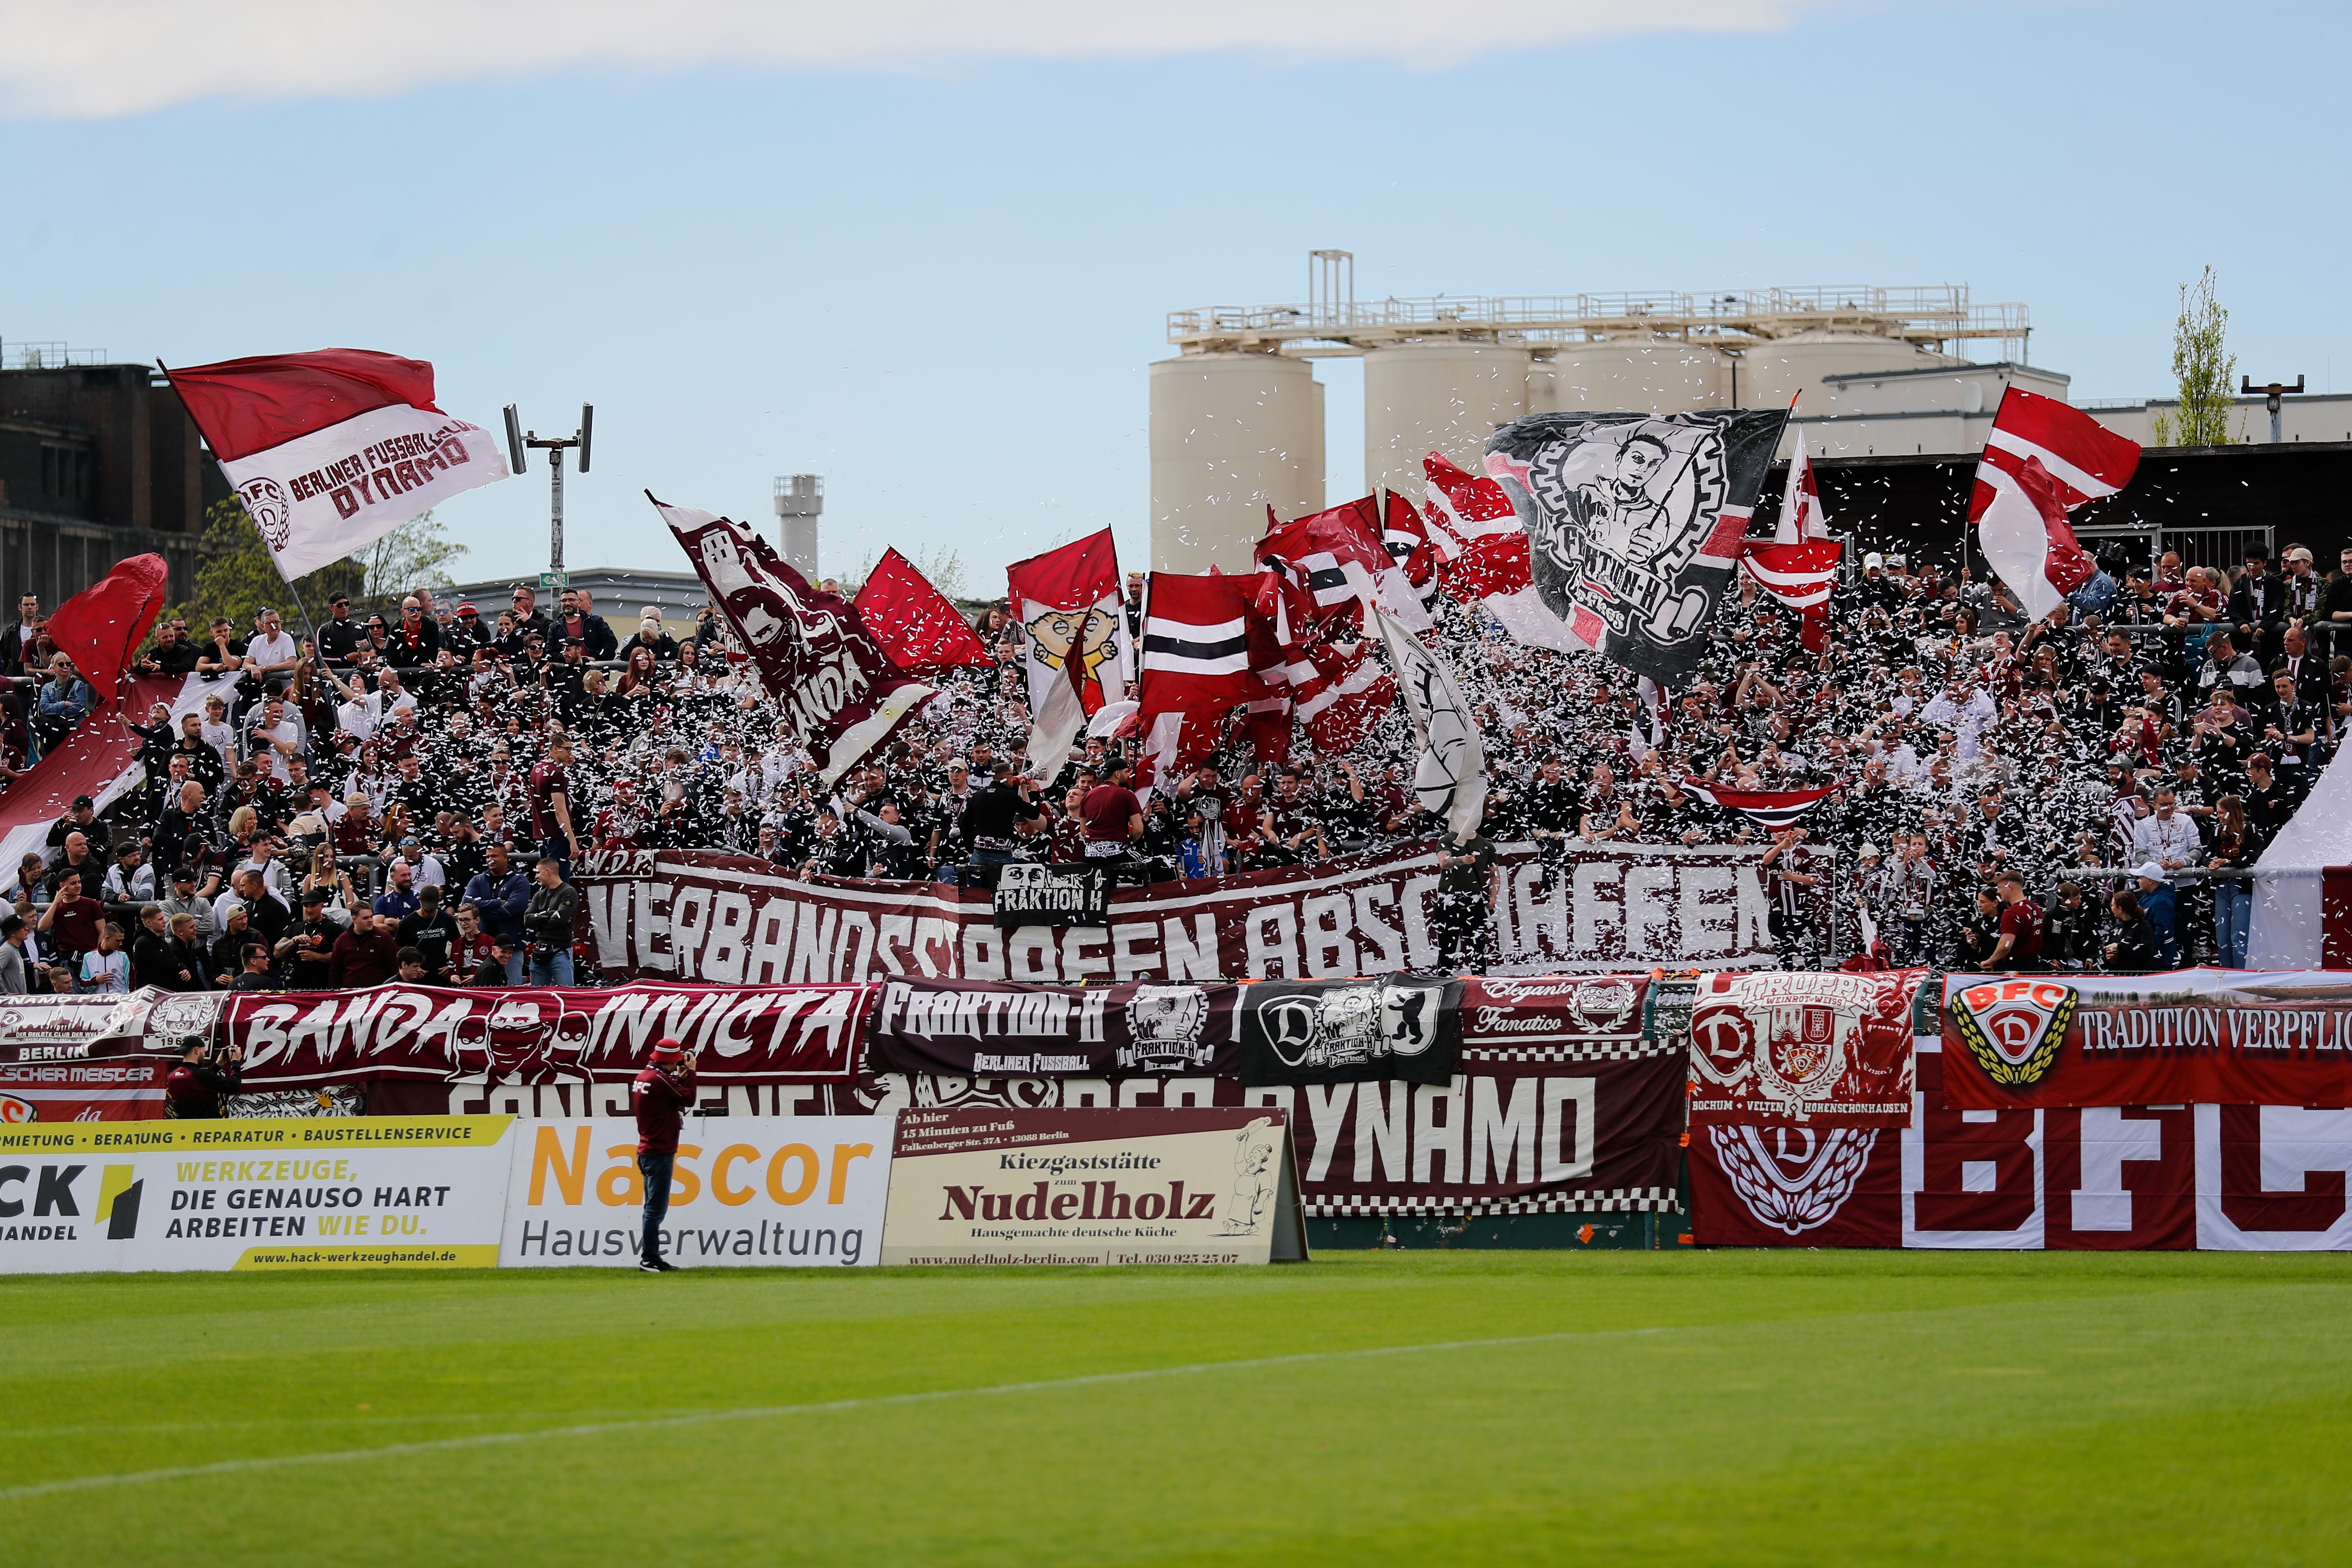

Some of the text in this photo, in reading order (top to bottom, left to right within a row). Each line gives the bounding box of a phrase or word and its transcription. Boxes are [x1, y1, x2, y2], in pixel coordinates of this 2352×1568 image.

[288, 453, 366, 502] BERLINER
[329, 436, 471, 520] DYNAMO
[788, 650, 871, 746] ANDA
[995, 888, 1102, 912] FRAKTION H
[1742, 974, 1876, 1011] TRUPPE
[1766, 995, 1842, 1006] WEINROT WEISS
[1965, 982, 2064, 1012] BFC
[877, 982, 1112, 1042] FRAKTION-H
[1473, 1005, 1562, 1033] Fanatico
[240, 989, 473, 1071] BANDA
[585, 989, 854, 1062] INVICTA
[2079, 1006, 2220, 1050] TRADITION
[161, 1036, 182, 1047] 196
[1135, 1041, 1195, 1059] FRAKTION-H
[1324, 1035, 1375, 1055] FRAKTION-H
[18, 1046, 89, 1061] BERLIN
[974, 1052, 1090, 1072] BERLINER FUSSBALL
[1331, 1054, 1366, 1067] Piefkes
[1791, 1049, 1814, 1059] BFC
[70, 1066, 154, 1082] MEISTER
[632, 1080, 651, 1094] BFC
[1692, 1099, 1908, 1114] BOCHUM VELTEN HOHENSCHÖNHAUSEN
[902, 1112, 949, 1124] Ab hier
[902, 1120, 1015, 1138] 15 Minuten zu Fuß
[0, 1127, 472, 1147] MIETUNG BERATUNG REPARATUR BAUSTELLENSERVICE
[901, 1140, 965, 1152] Falkenberger
[965, 1138, 981, 1146] Str.
[1011, 1134, 1038, 1143] 13088
[1038, 1130, 1069, 1140] Berlin
[176, 1159, 358, 1182] WERKZEUGE,
[527, 1125, 875, 1207] Nascor
[999, 1152, 1161, 1177] Kiezgaststätte
[171, 1186, 451, 1210] DIE GENAUSO HART
[938, 1180, 1216, 1221] Nudelholz
[165, 1214, 427, 1239] ARBEITEN WIE DU.
[970, 1226, 1177, 1240] Hausgemachte deutsche Küche
[521, 1219, 863, 1265] Hausverwaltung
[254, 1250, 456, 1265] www.hack-werkzeughandel.de
[908, 1253, 1240, 1266] www.nudelholz-berlin.com Tel. 030 925 25 07
